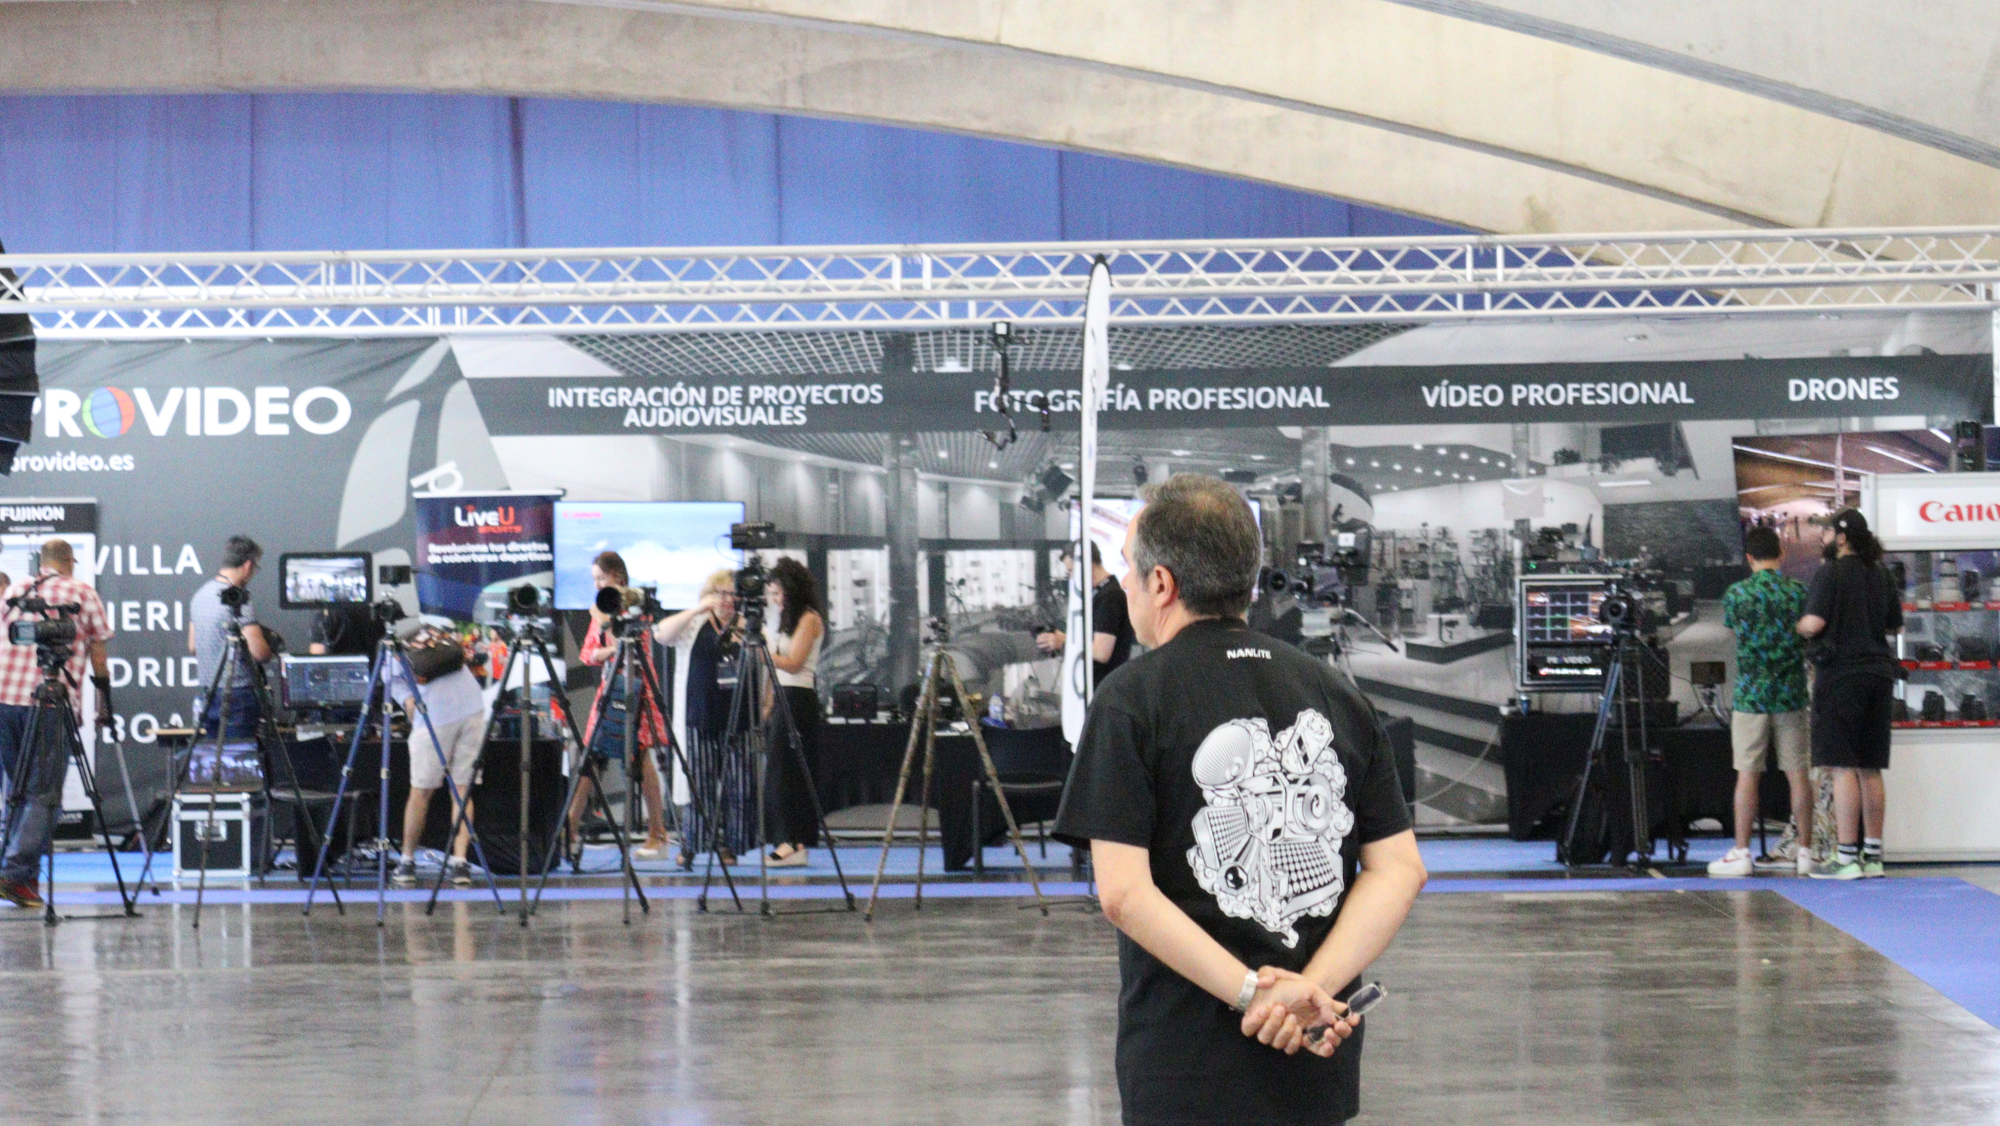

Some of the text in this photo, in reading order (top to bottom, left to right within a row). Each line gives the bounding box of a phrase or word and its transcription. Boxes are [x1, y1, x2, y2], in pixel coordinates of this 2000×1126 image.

[548, 382, 884, 408] INTEGRACIÓN DE PROYECTOS
[974, 383, 1330, 412] FOTOGRFÍA PROFESIONAL
[1421, 379, 1695, 407] VÍDEO PROFESIONAL
[1788, 377, 1900, 401] DRONES
[32, 386, 352, 439] ROVIDEO
[623, 406, 808, 427] AUDIOVISUALES
[0, 506, 66, 522] FUJINON
[1226, 648, 1271, 659] NANLITE
